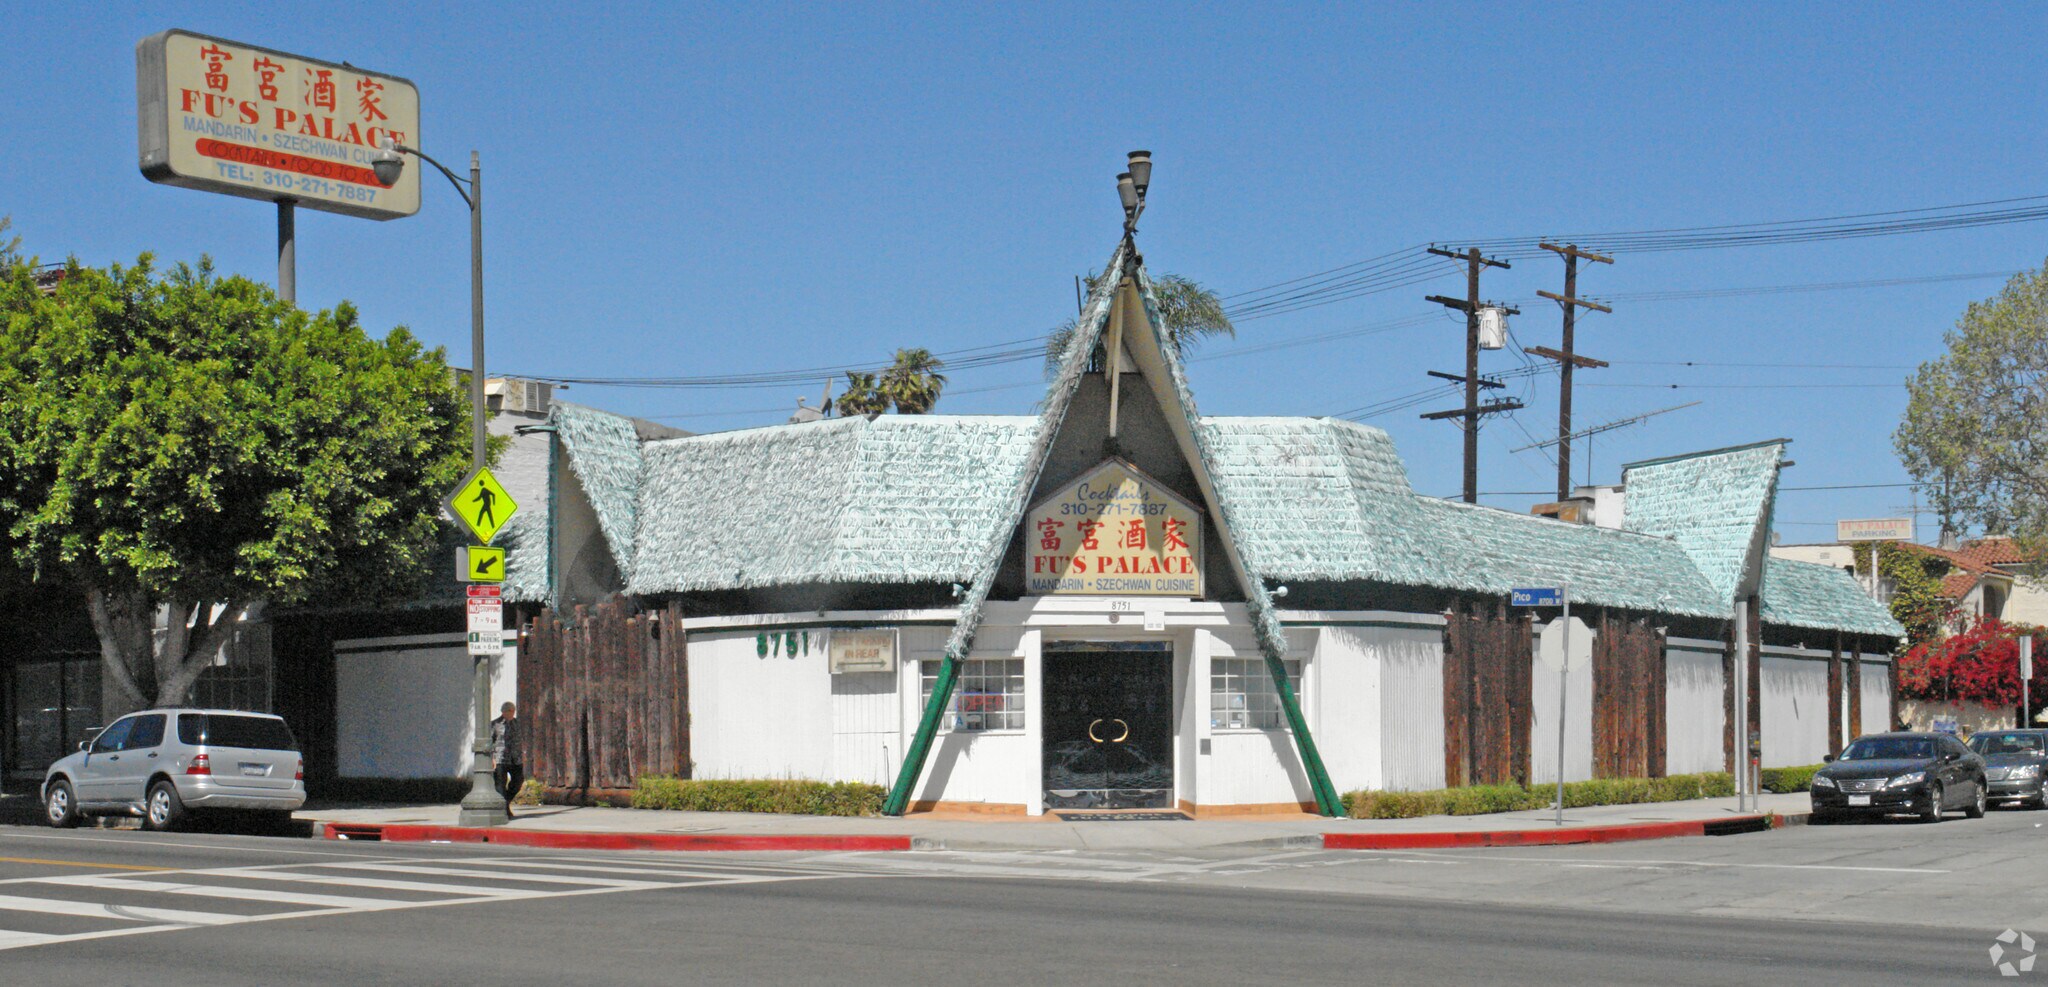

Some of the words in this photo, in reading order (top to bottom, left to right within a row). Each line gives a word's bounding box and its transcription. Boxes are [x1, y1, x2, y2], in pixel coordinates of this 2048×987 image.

[180, 87, 260, 125] FU'S
[183, 115, 258, 144] MANDARIN
[273, 132, 348, 160] SZECHWAN
[207, 141, 277, 168] COCKTAILS
[290, 156, 333, 176] FOOD
[338, 164, 358, 181] TO
[216, 162, 254, 182] TEL:
[263, 171, 377, 204] 310-271-7887
[1077, 482, 1150, 502] Cocktails
[1060, 503, 1168, 516] 310-271-7887
[1852, 530, 1897, 538] PARKING
[1033, 555, 1087, 575] FU'S
[1096, 555, 1194, 575] PALACE
[1032, 578, 1084, 591] MANDARIN
[1095, 578, 1151, 591] SZECHWAN
[1155, 578, 1195, 591] CUISINE
[479, 605, 500, 613] STOPPING
[1111, 602, 1131, 611] 8751
[756, 631, 809, 657] 8751
[844, 649, 854, 659] IN
[855, 648, 880, 659] REAR
[957, 695, 1005, 712] OPEN
[956, 715, 964, 726] A
